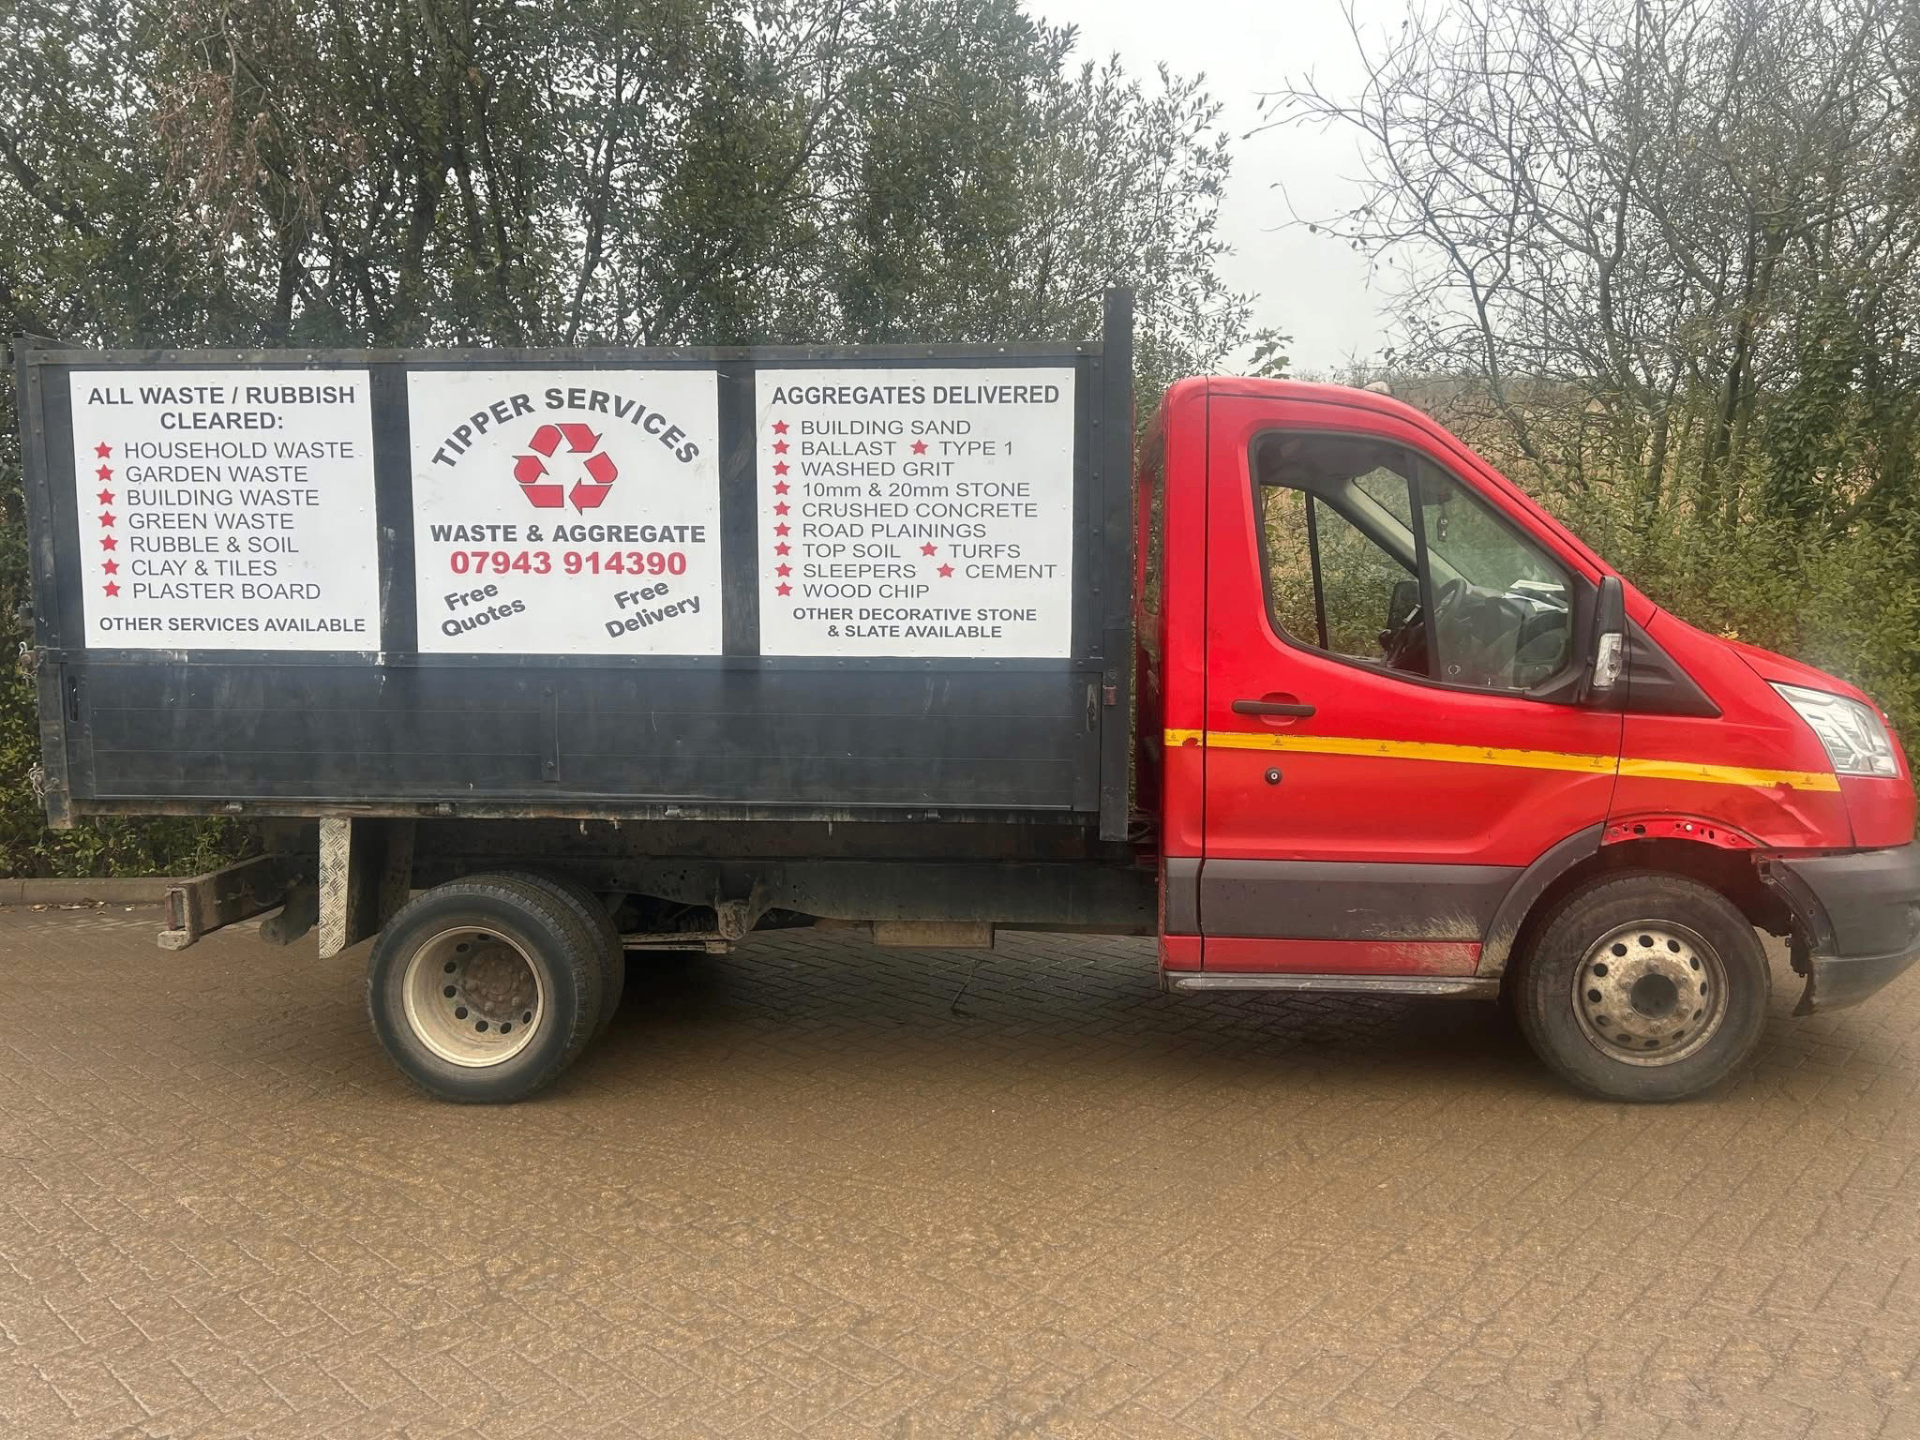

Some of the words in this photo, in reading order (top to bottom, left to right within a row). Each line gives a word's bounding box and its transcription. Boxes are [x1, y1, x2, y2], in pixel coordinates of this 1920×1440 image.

[87, 387, 134, 405] ALL
[139, 387, 225, 405] WASTE
[231, 386, 239, 404] /
[245, 386, 355, 404] RUBBISH
[771, 386, 926, 405] AGGREGATES
[933, 385, 1060, 404] DELIVERED
[160, 412, 284, 430] CLEARED:
[431, 393, 536, 468] TIPPER
[544, 387, 701, 464] SERVICES
[801, 420, 904, 435] BUILDING
[910, 420, 972, 435] SAND
[124, 441, 268, 459] HOUSEHOLD
[273, 441, 354, 459] WASTE
[801, 441, 897, 456] BALLAST
[939, 441, 996, 456] TYPE
[1004, 441, 1013, 455] 1
[125, 466, 222, 483] GARDEN
[227, 465, 309, 483] WASTE
[801, 462, 896, 477] WASHED
[902, 462, 955, 477] GRIT
[127, 489, 233, 506] BUILDING
[239, 489, 320, 506] WASTE
[802, 482, 862, 497] 10mm
[868, 482, 883, 497] &
[888, 482, 949, 497] 20mm
[955, 482, 1031, 497] STONE
[802, 503, 909, 518] CRUSHED
[915, 503, 1038, 518] CONCRETE
[128, 513, 208, 530] GREEN
[213, 513, 295, 530] WASTE
[430, 524, 518, 543] WASTE
[526, 524, 544, 543] &
[552, 525, 706, 543] AGGREGATE
[802, 523, 864, 538] ROAD
[871, 523, 987, 538] PLAININGS
[130, 536, 220, 553] RUBBLE
[226, 536, 241, 554] &
[247, 536, 300, 553] SOIL
[802, 544, 846, 558] TOP
[852, 544, 901, 559] SOIL
[947, 544, 1021, 559] TURFS
[131, 560, 188, 577] CLAY
[194, 560, 209, 577] &
[214, 560, 278, 577] TILES
[450, 551, 552, 574] 07943
[562, 551, 687, 576] 914390
[803, 564, 917, 579] SLEEPERS
[965, 564, 1058, 579] CEMENT
[133, 583, 235, 600] PLASTER
[241, 583, 321, 600] BOARD
[443, 583, 499, 612] Free
[613, 582, 670, 610] Free
[803, 584, 872, 599] WOOD
[878, 584, 930, 599] CHIP
[441, 598, 526, 637] Quotes
[605, 595, 702, 638] Delivery
[792, 607, 854, 620] OTHER
[858, 608, 972, 621] DECORATIVE
[976, 608, 1037, 621] STONE
[99, 617, 163, 631] OTHER
[168, 617, 260, 632] SERVICES
[264, 618, 366, 632] AVAILABLE
[827, 625, 840, 638] &
[844, 625, 900, 638] SLATE
[904, 625, 1002, 638] AVAILABLE
